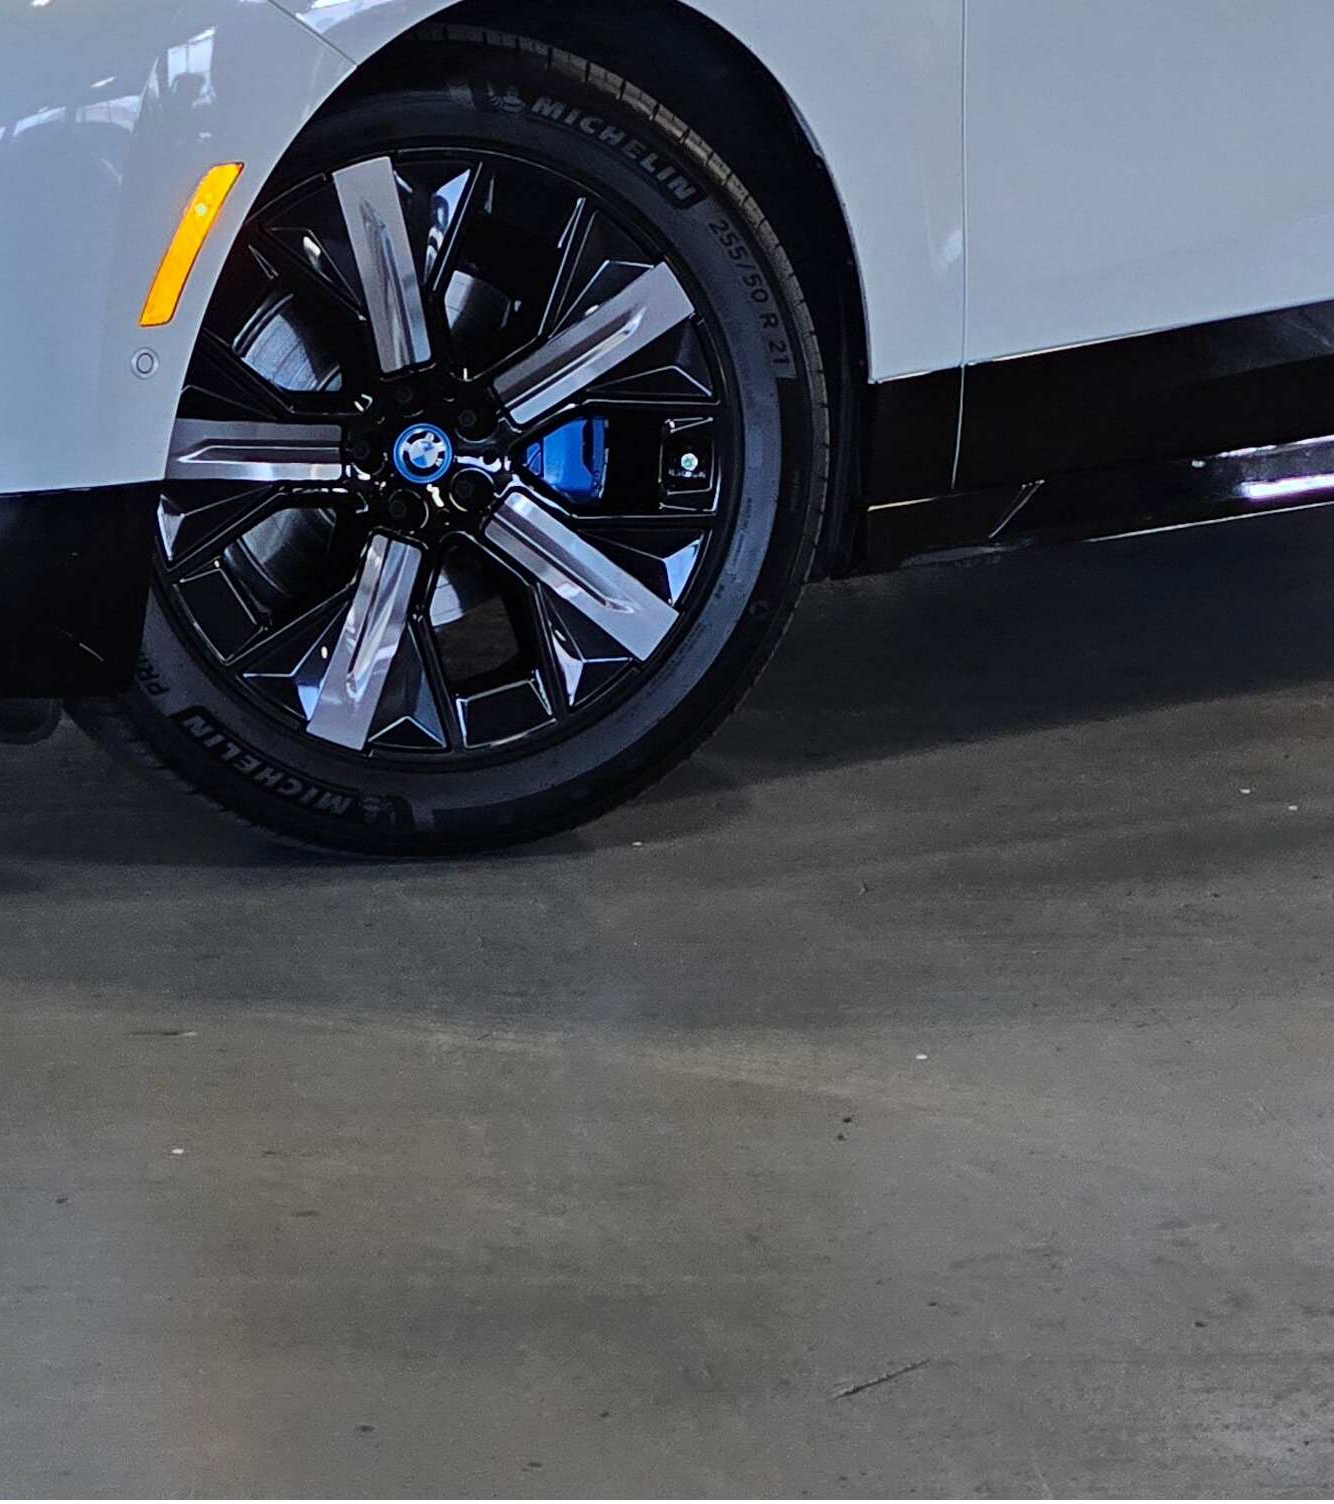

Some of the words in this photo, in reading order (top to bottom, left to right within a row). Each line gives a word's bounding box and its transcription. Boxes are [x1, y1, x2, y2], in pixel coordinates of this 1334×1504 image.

[531, 96, 697, 200] MICHELIN
[709, 219, 769, 303] 255/50
[182, 714, 352, 814] MICHELIN
